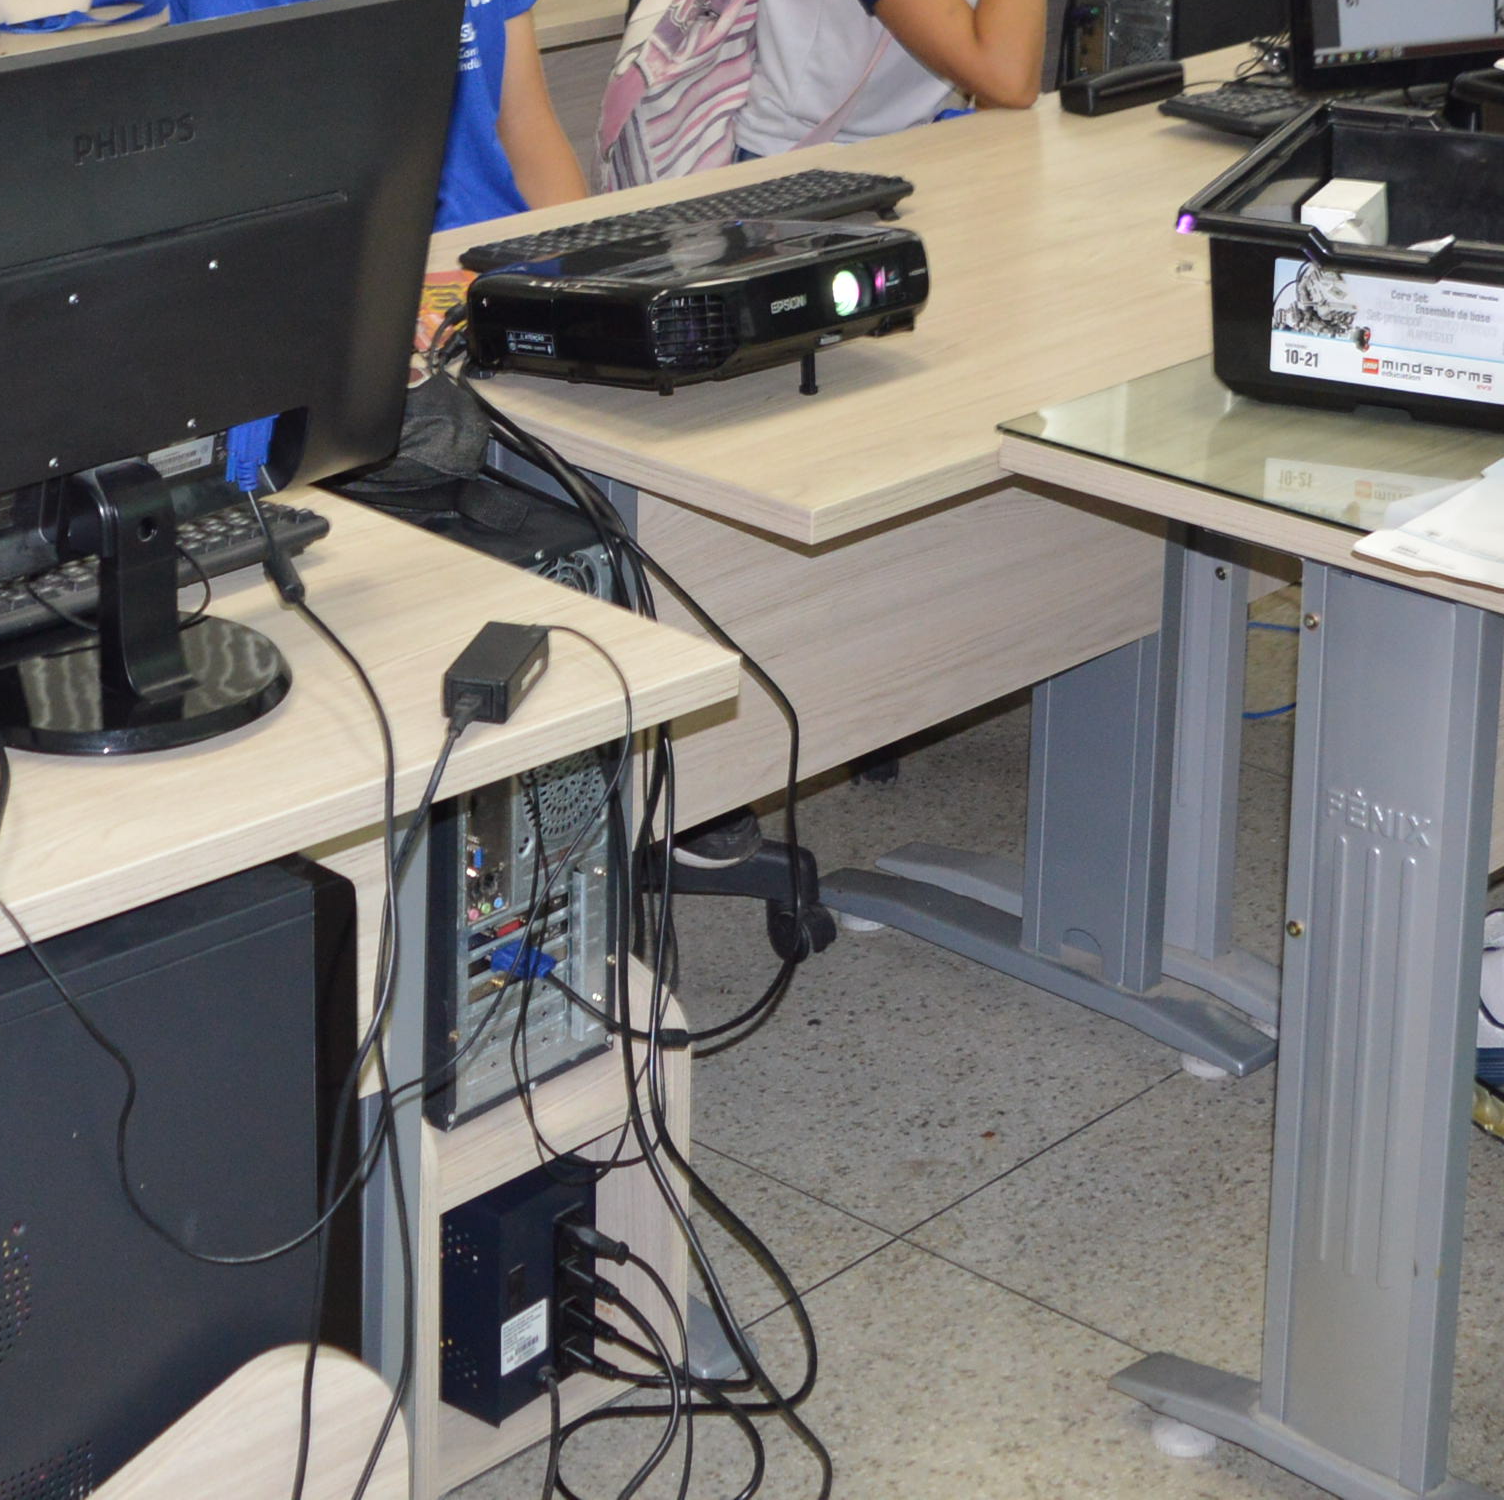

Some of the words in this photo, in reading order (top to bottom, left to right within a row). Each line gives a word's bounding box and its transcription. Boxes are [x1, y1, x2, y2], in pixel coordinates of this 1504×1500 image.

[73, 112, 196, 166] PHILIPS
[770, 294, 807, 315] EPSON
[1391, 290, 1412, 301] Core
[1285, 349, 1319, 368] 10-21
[1382, 359, 1493, 384] mindstorms
[1382, 371, 1422, 381] education
